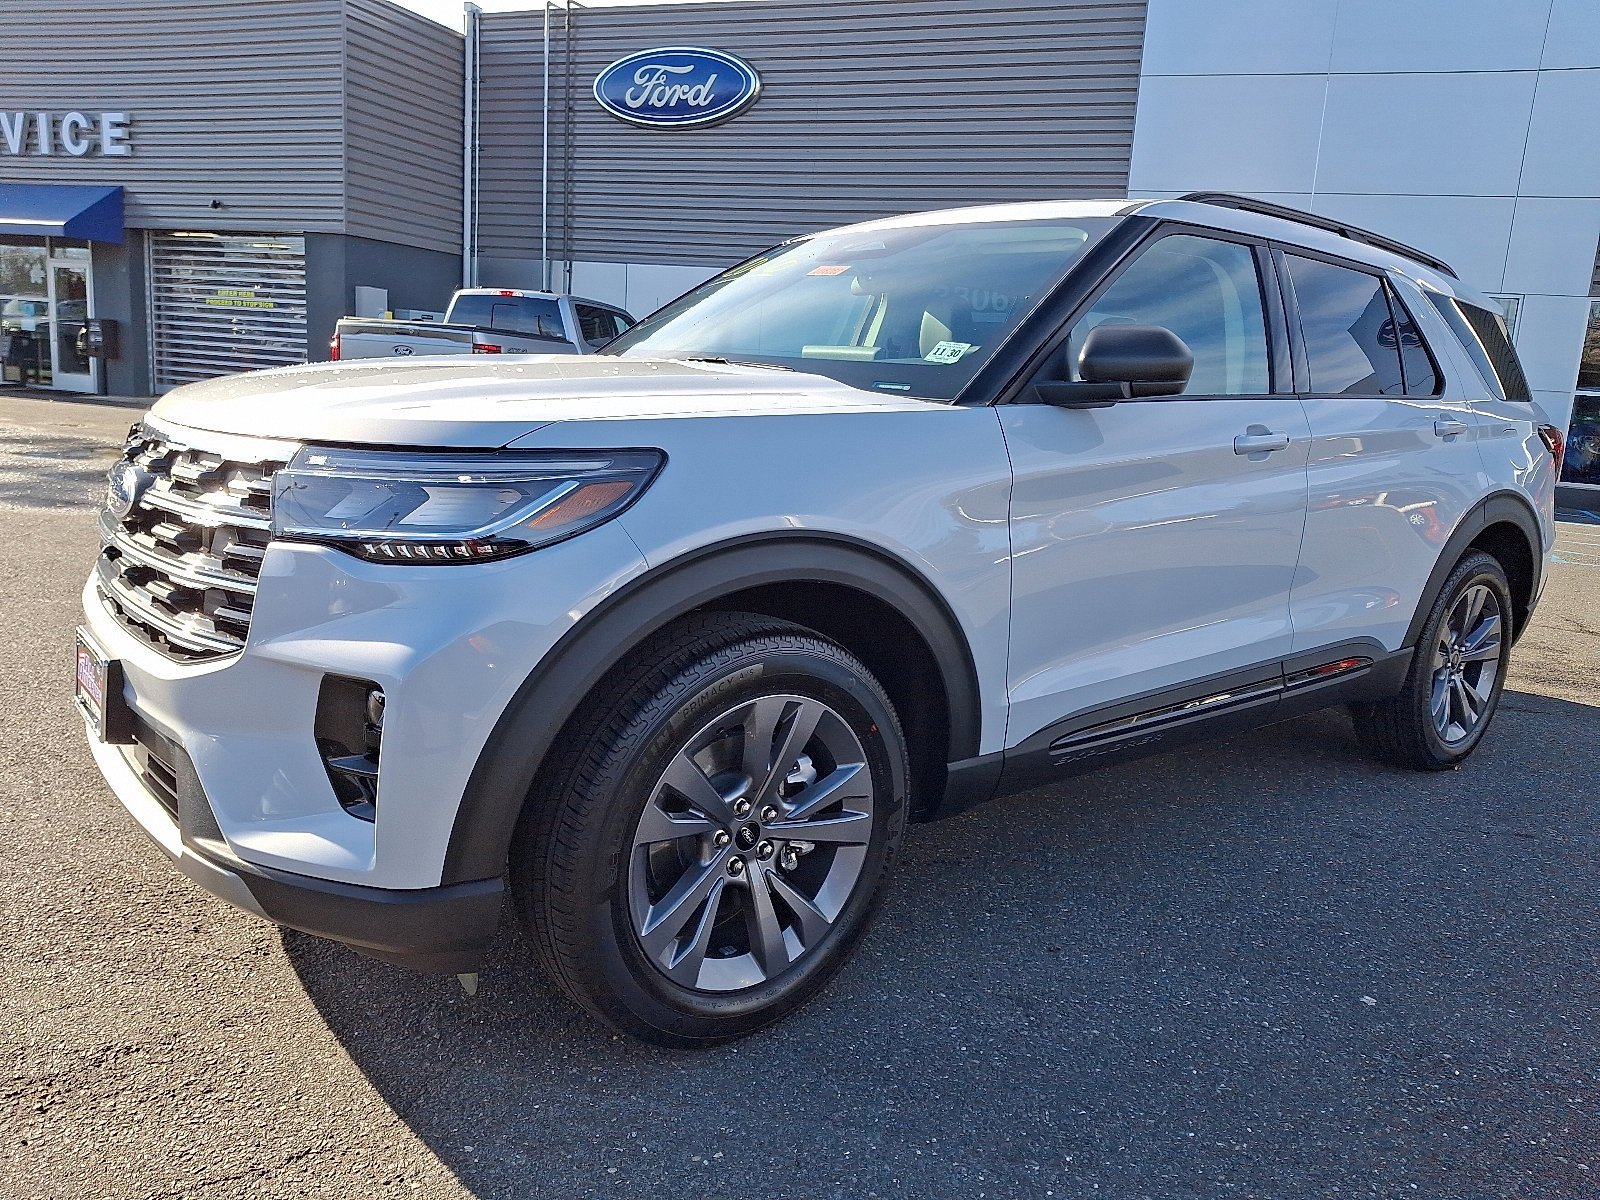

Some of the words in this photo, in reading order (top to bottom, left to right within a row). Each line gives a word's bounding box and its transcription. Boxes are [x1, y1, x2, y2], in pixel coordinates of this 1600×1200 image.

[625, 64, 718, 108] Ford
[0, 111, 131, 157] VICE
[205, 298, 232, 306] PROCEED
[932, 347, 947, 356] 11
[946, 348, 962, 358] 30
[682, 677, 734, 718] PRIMACY
